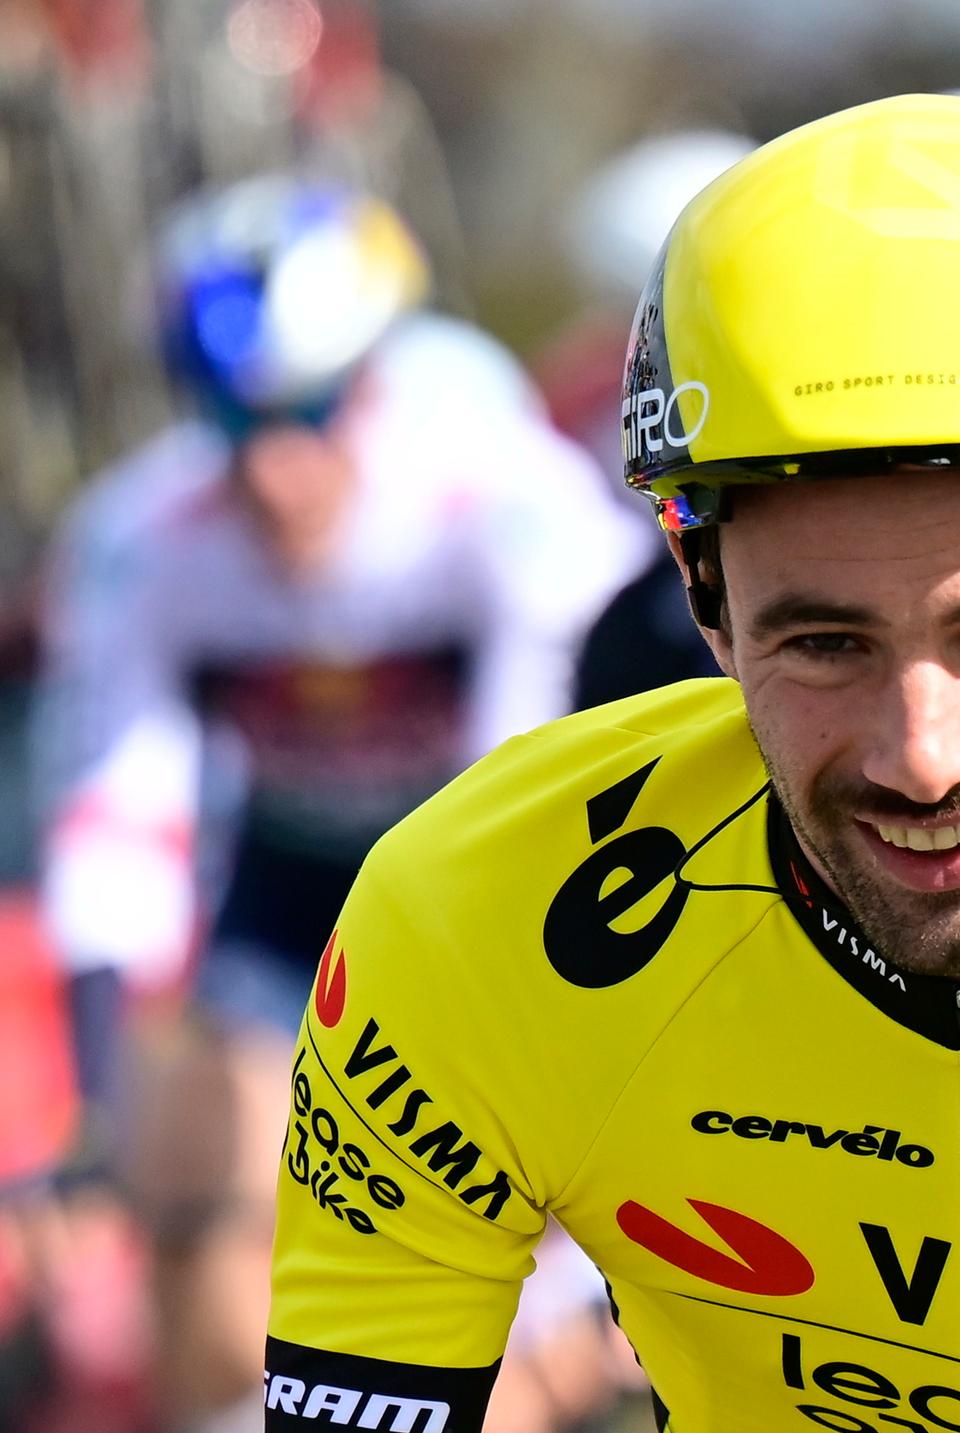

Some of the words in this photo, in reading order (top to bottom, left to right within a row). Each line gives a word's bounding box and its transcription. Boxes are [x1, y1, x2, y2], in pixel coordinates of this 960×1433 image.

[794, 381, 834, 396] GIRO
[843, 375, 894, 390] SPORT
[822, 908, 906, 992] VISMA
[291, 1046, 405, 1210] lease
[343, 1017, 512, 1221] VISMA
[691, 1110, 935, 1168] cervélo
